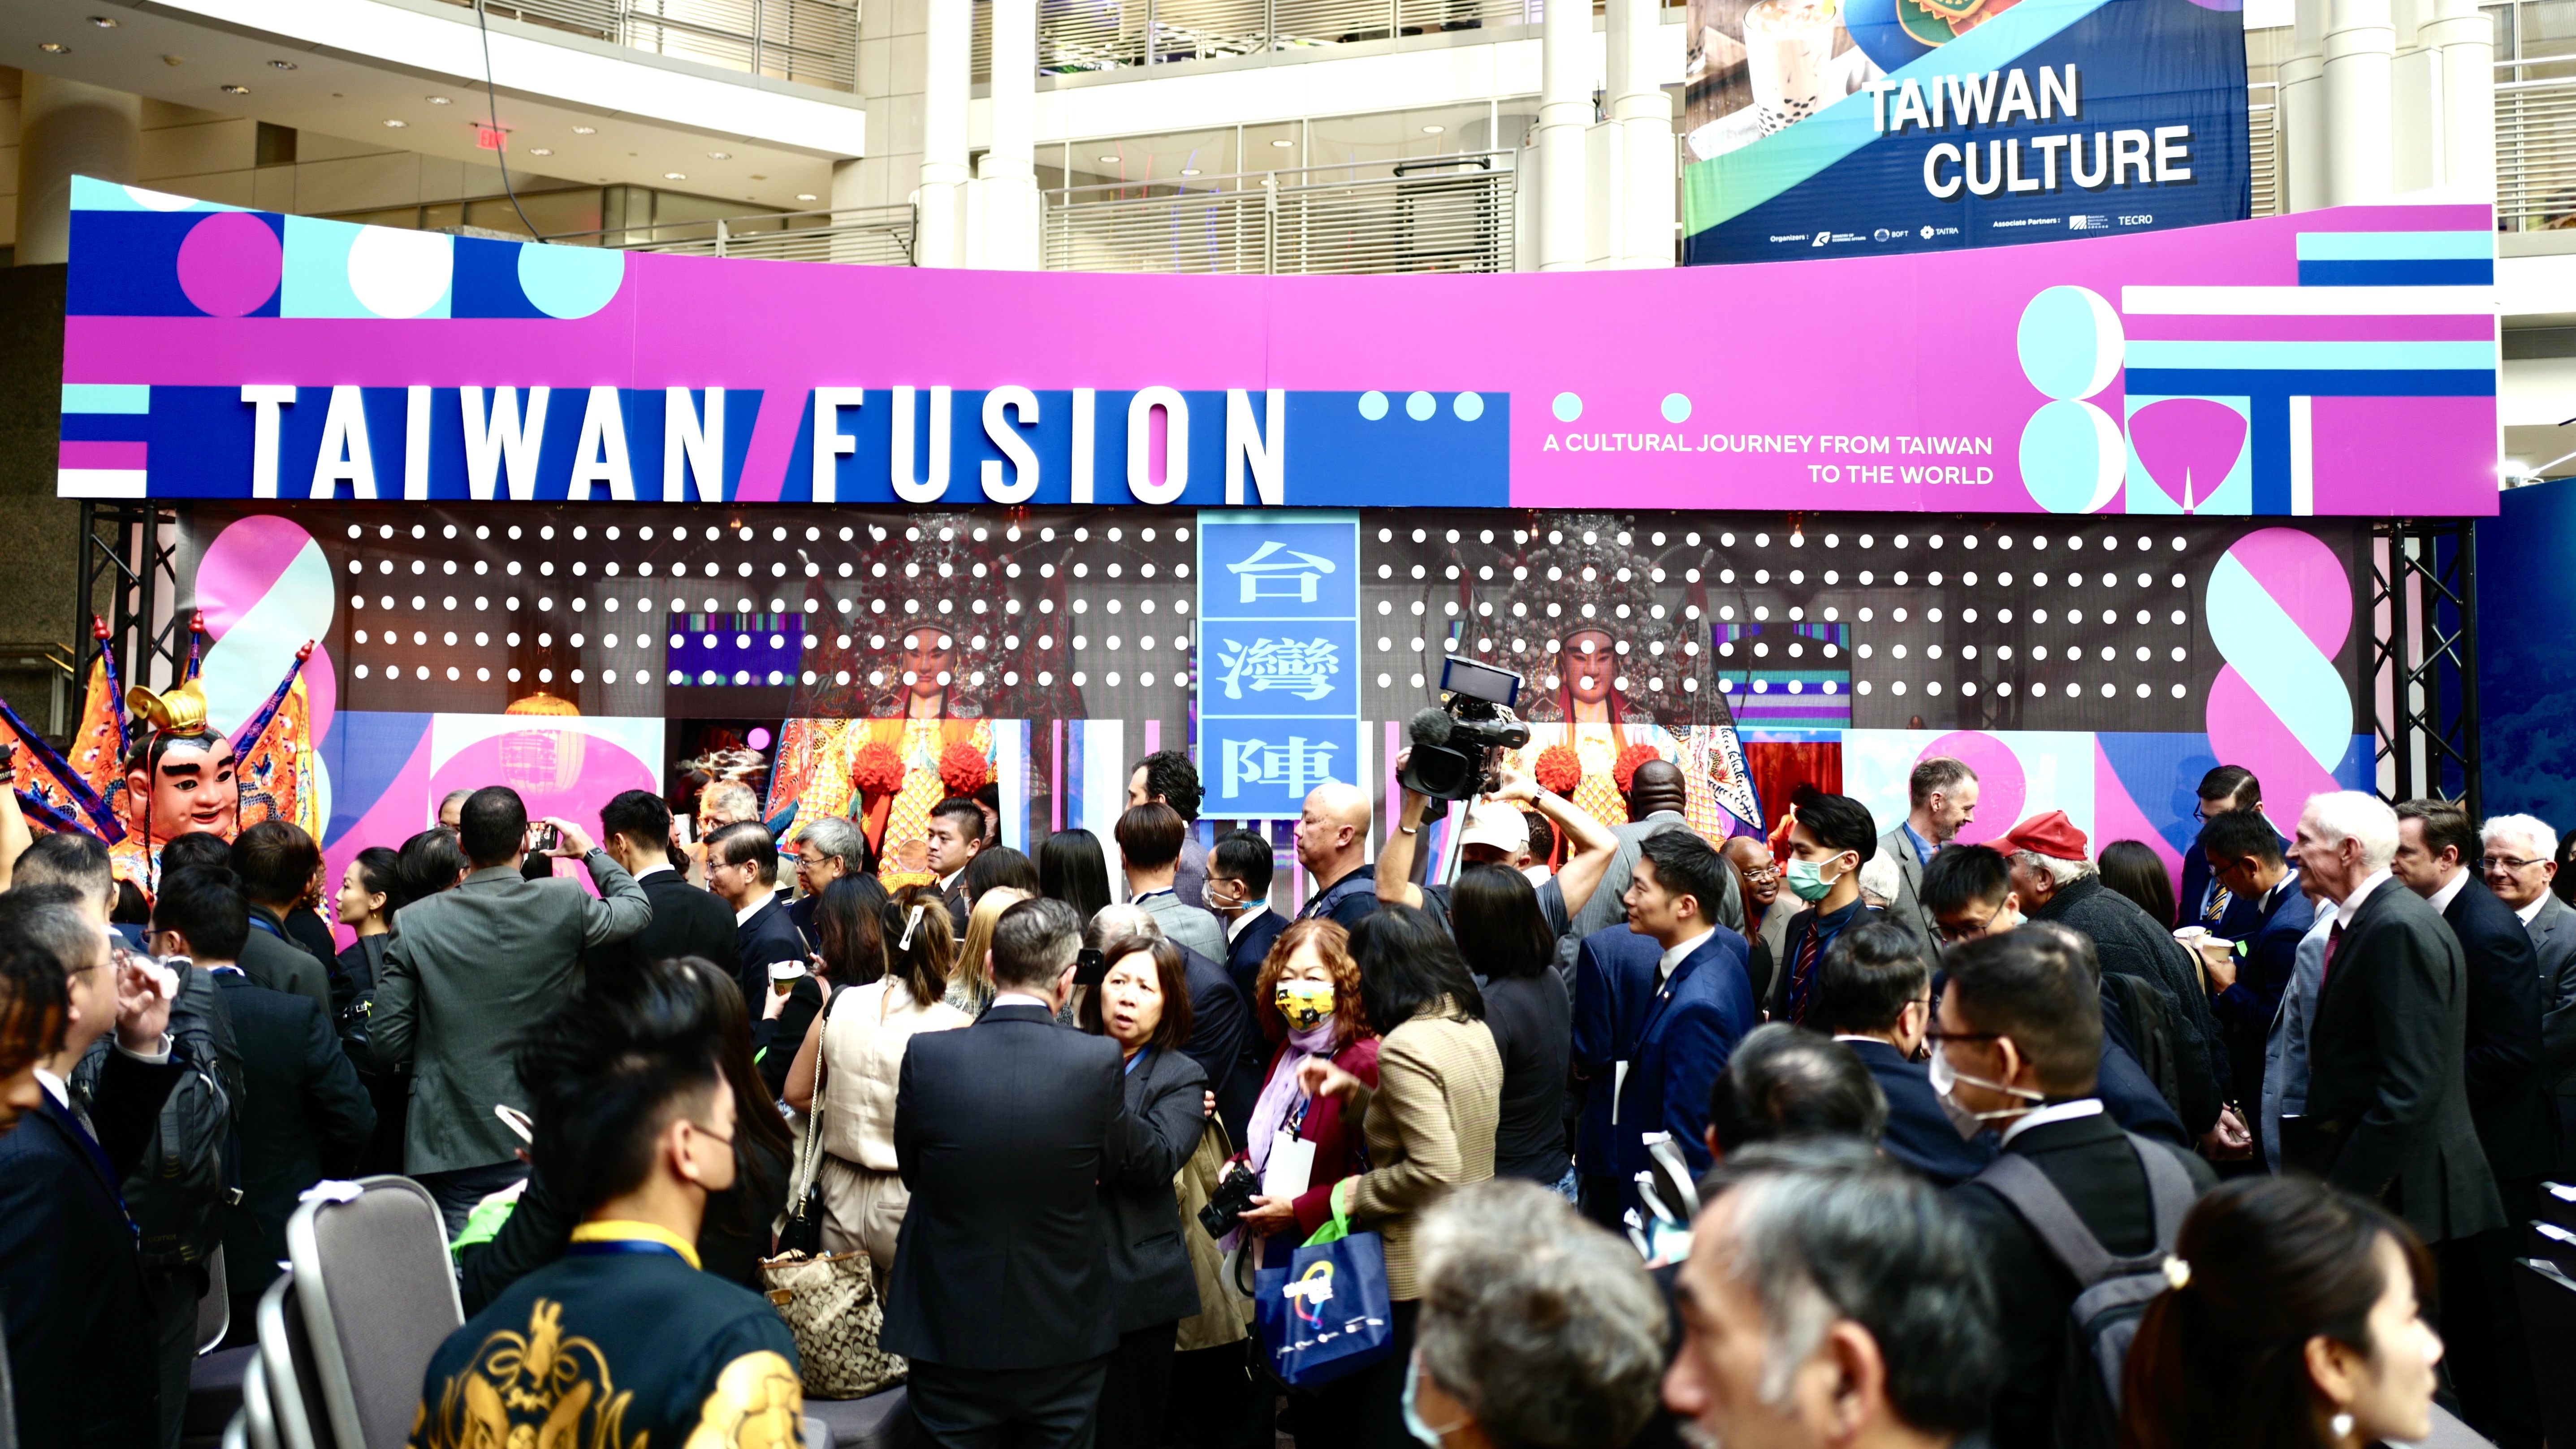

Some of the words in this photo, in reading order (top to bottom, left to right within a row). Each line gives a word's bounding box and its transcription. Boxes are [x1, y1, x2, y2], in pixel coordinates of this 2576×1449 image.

[1862, 64, 2077, 132] TAIWAN
[1923, 125, 2191, 198] CULTURE
[1993, 219, 2027, 227] Associate
[2118, 215, 2152, 225] TECRO
[241, 385, 725, 502] TAIWAN
[812, 385, 1285, 505] FUSION
[1543, 434, 1560, 451] A
[1565, 433, 1692, 451] CULTURAL
[1696, 434, 1814, 453] JOURNEY
[1820, 435, 1889, 454] FROM
[1896, 436, 1992, 454] TAIWAN
[1807, 465, 1840, 483] TO
[1846, 465, 1894, 483] THE
[1900, 466, 1993, 484] WORLD
[1216, 541, 1341, 799] 台灣陣
